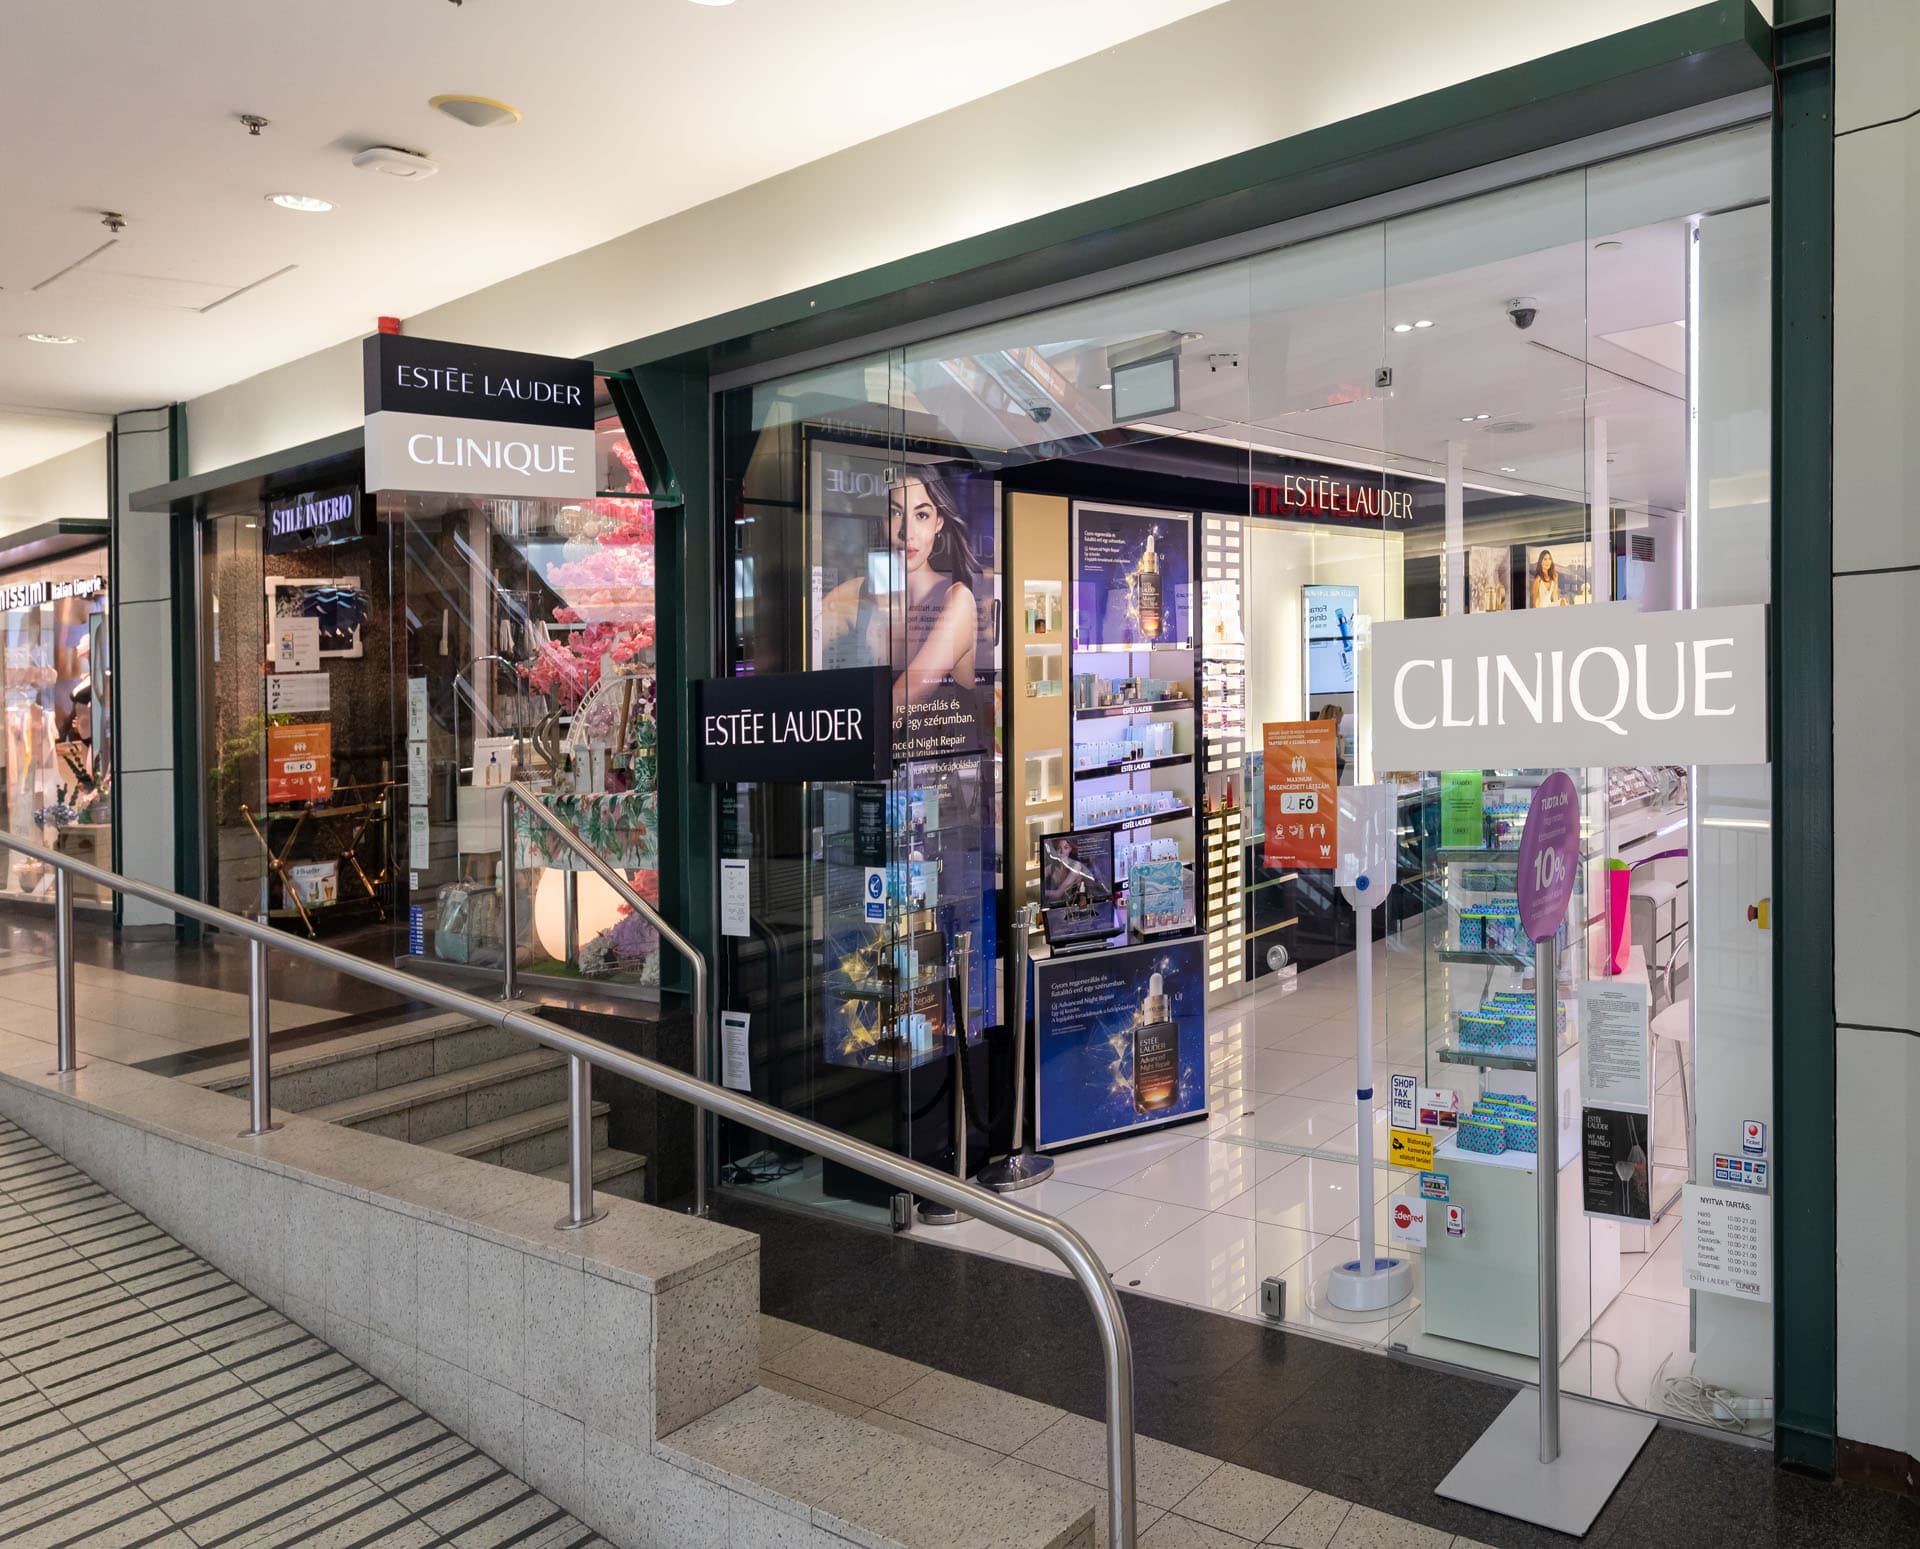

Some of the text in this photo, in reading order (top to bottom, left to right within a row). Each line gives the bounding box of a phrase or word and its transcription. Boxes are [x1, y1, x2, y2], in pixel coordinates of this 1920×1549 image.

[485, 376, 582, 406] LAUDER
[408, 434, 576, 476] CLINIQUE
[1346, 484, 1413, 520] LAUDER
[306, 494, 353, 528] INTERIO
[1394, 638, 1736, 736] CLINIQUE
[896, 698, 960, 716] regenerálás és
[1135, 705, 1152, 713] LAUDER
[772, 708, 862, 743] LAUDER
[908, 718, 922, 730] egy
[924, 712, 975, 727] szérumban.
[916, 736, 938, 750] Night
[940, 734, 966, 748] Repair
[1134, 762, 1151, 770] LAUDER
[1135, 818, 1152, 828] LAUDER
[1534, 846, 1566, 892] 10%
[1394, 1078, 1414, 1089] SHOP
[1394, 1088, 1408, 1098] TAX
[1394, 1098, 1412, 1109] FREE
[1588, 1122, 1608, 1130] LAUDER
[1700, 1196, 1752, 1210] NYITVA TARTÁS:
[1394, 1210, 1424, 1223] Edenred
[1707, 1278, 1730, 1286] LAUDER
[1736, 1282, 1760, 1292] CLINIQUE
